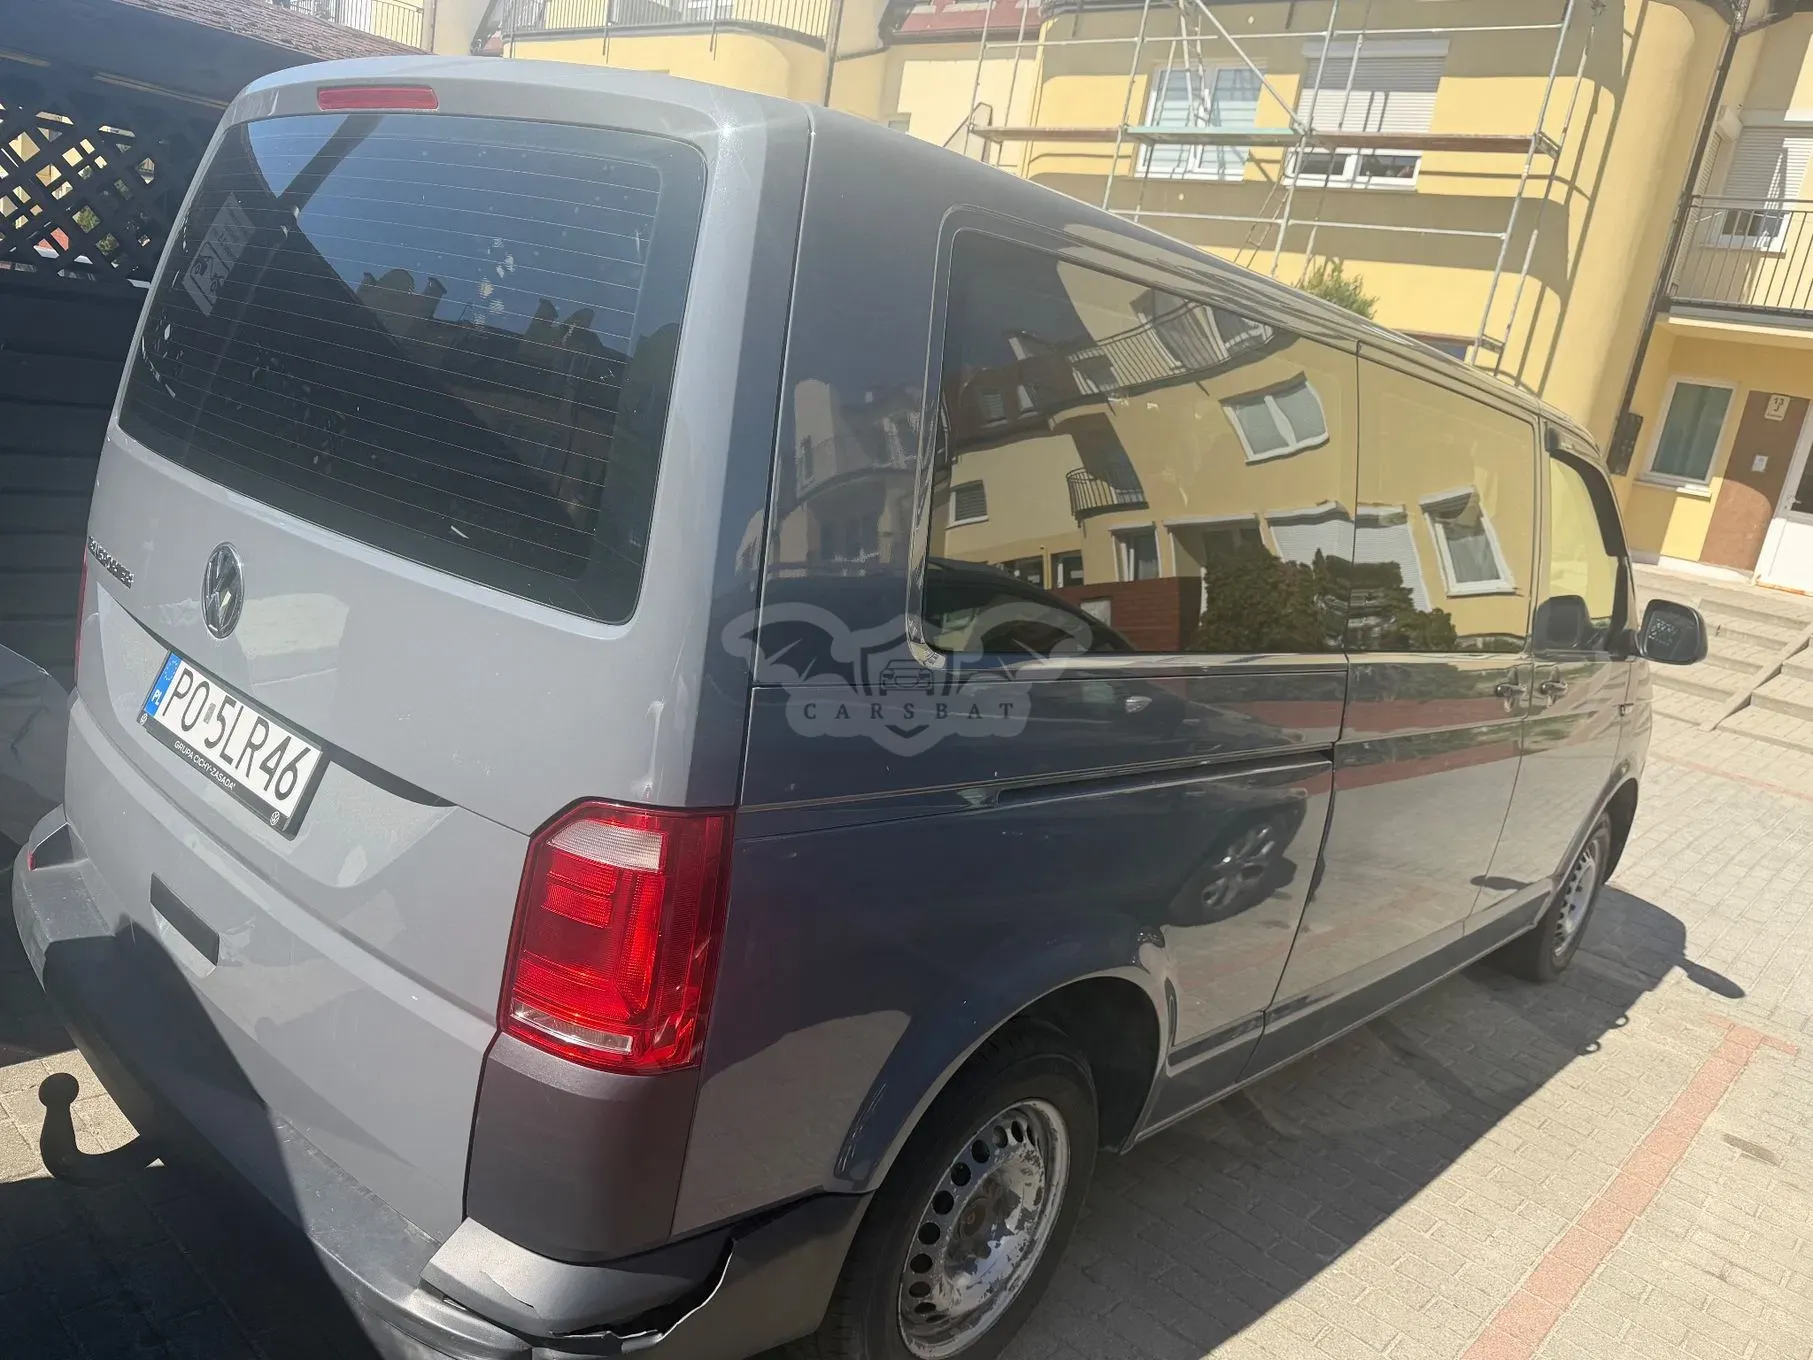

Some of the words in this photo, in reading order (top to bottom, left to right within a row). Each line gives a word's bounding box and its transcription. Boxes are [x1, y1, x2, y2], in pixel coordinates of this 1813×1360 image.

[151, 689, 162, 706] PL
[174, 740, 193, 760] GRUPA
[204, 695, 311, 801] 5LR46
